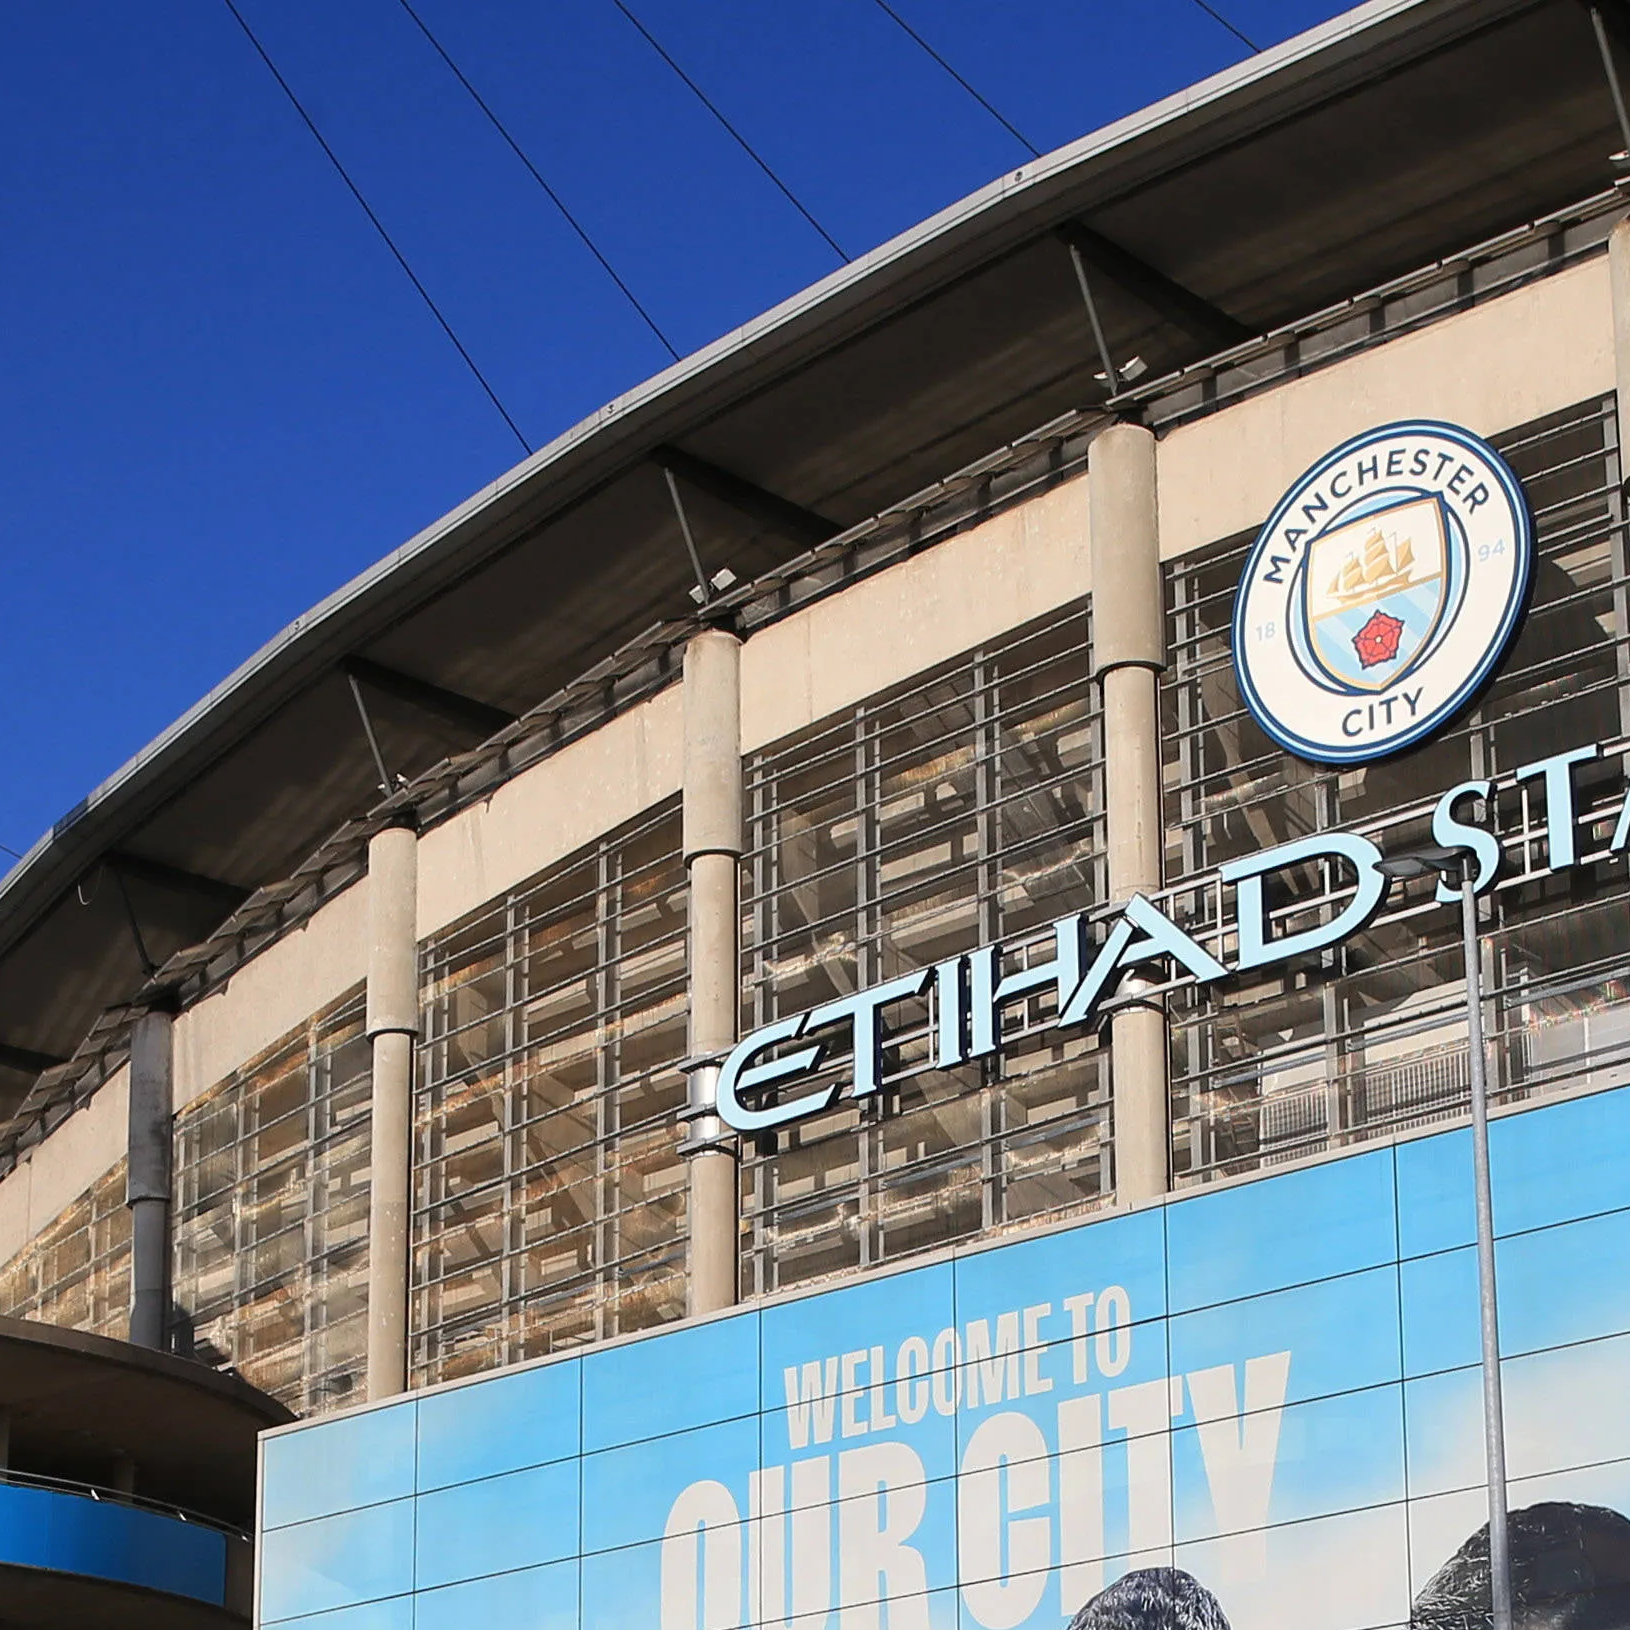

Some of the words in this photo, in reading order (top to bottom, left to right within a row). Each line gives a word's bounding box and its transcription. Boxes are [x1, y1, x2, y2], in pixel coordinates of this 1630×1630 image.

[1263, 448, 1490, 584] MANCHESTER
[1477, 539, 1506, 563] 94
[1255, 622, 1276, 641] 18
[1342, 687, 1424, 737] CITY
[713, 831, 1388, 1132] ETIHAD
[783, 1302, 1053, 1450] WELCOME
[1063, 1284, 1131, 1384] TO
[959, 1350, 1292, 1630] CITY
